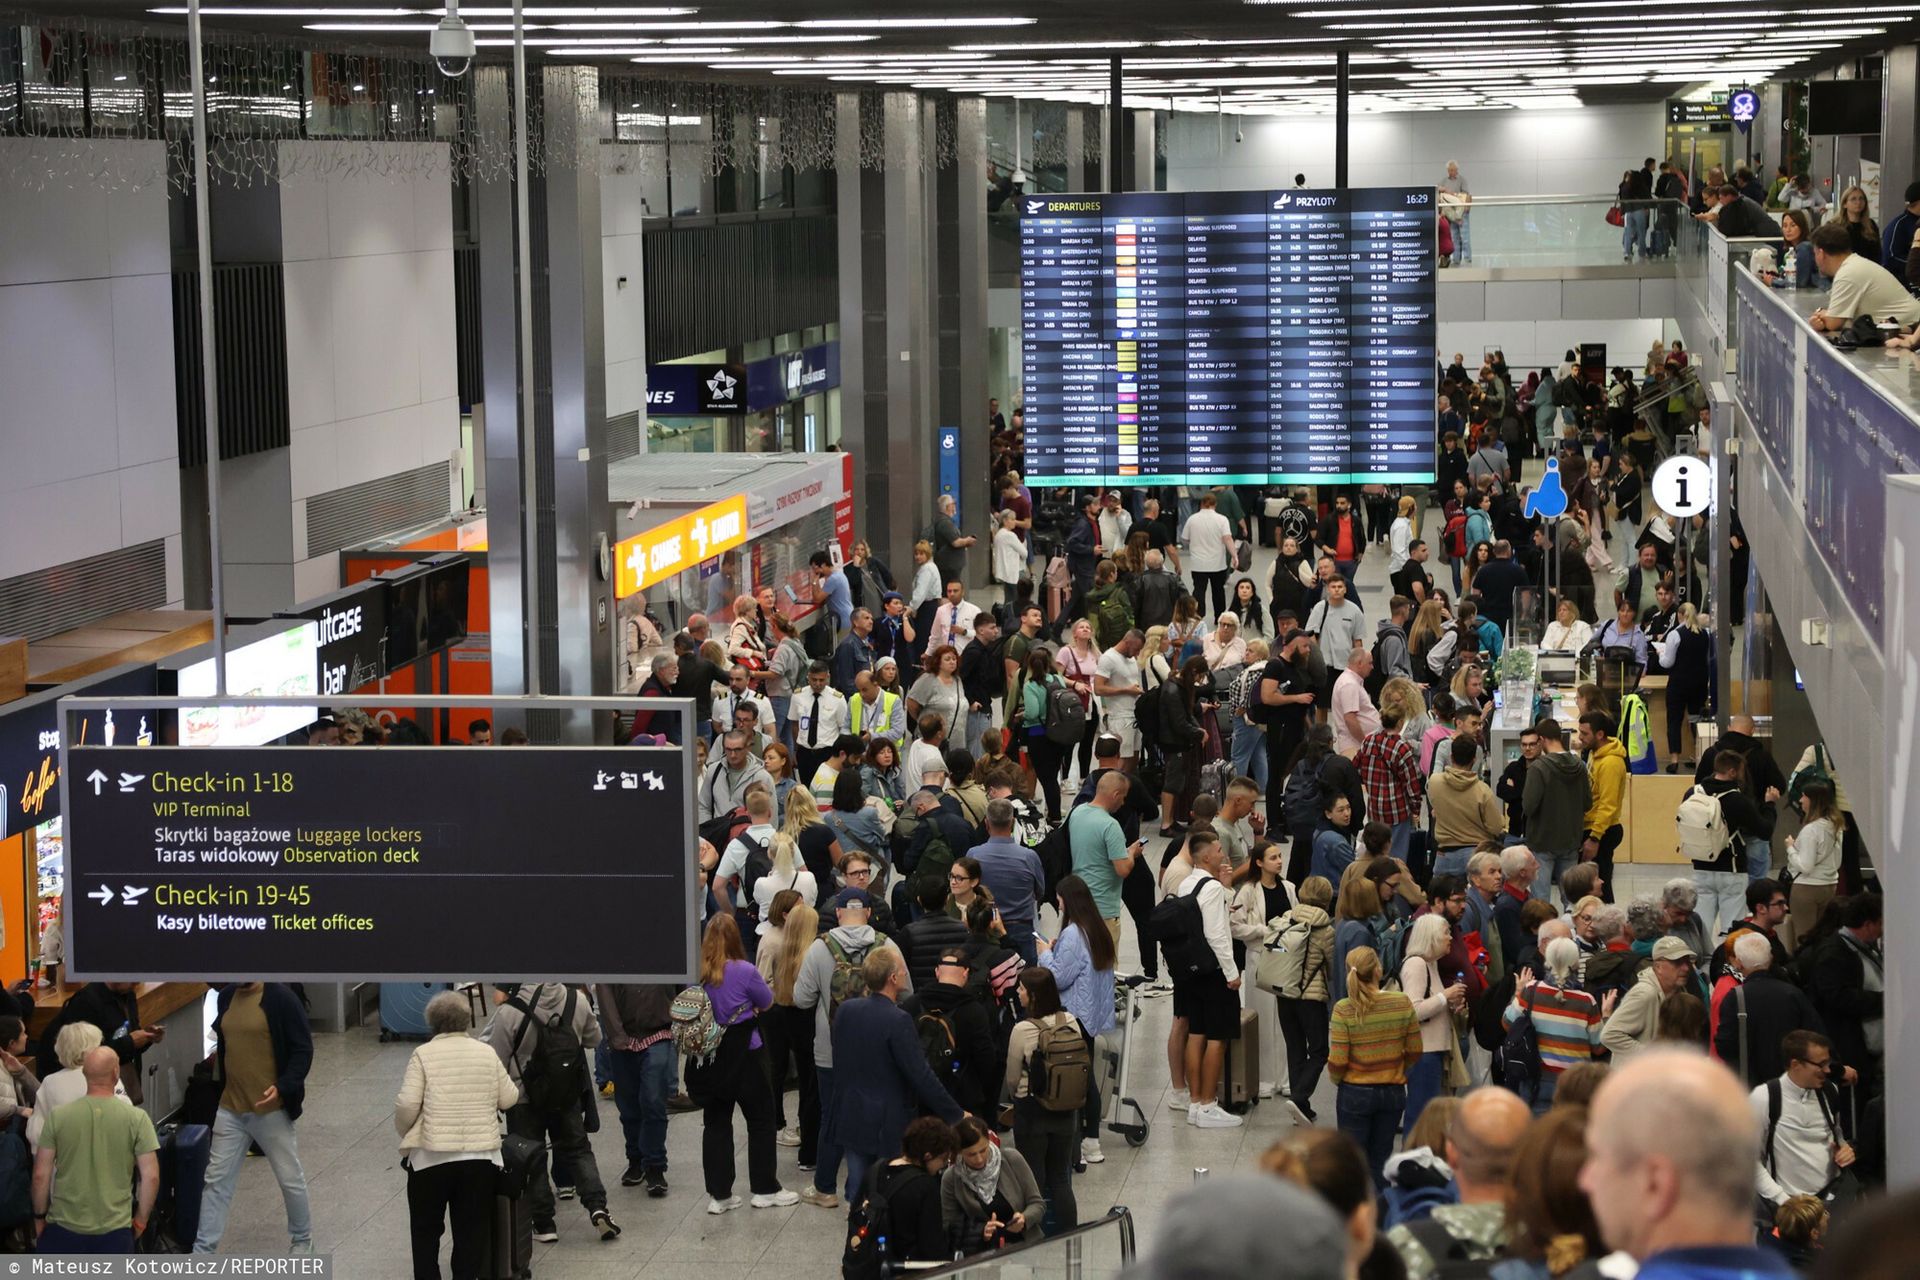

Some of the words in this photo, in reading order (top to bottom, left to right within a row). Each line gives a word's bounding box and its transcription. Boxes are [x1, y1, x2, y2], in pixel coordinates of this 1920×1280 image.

[1048, 202, 1101, 212] DEPARTURES
[1296, 197, 1337, 206] PRZYLOTY
[1407, 195, 1428, 204] 16:29
[712, 511, 740, 545] KANTOR
[651, 535, 682, 573] CHANGE
[323, 662, 346, 696] bar
[152, 771, 245, 793] Check-in
[253, 772, 294, 793] 1-18
[153, 802, 178, 817] VIP
[182, 802, 251, 817] Terminal
[155, 827, 208, 846] Skrytki
[214, 827, 291, 846] bagażowe
[297, 827, 360, 846] Luggage
[366, 827, 422, 843] lockers
[155, 848, 196, 863] Taras
[201, 847, 279, 866] widokowy
[283, 847, 377, 863] Observation
[383, 847, 419, 863] deck
[155, 884, 248, 906] Check-in
[256, 885, 311, 906] 19-45
[157, 915, 193, 934] Kasy
[199, 914, 266, 930] biletowe
[272, 914, 317, 931] Ticket
[322, 914, 374, 931] offices
